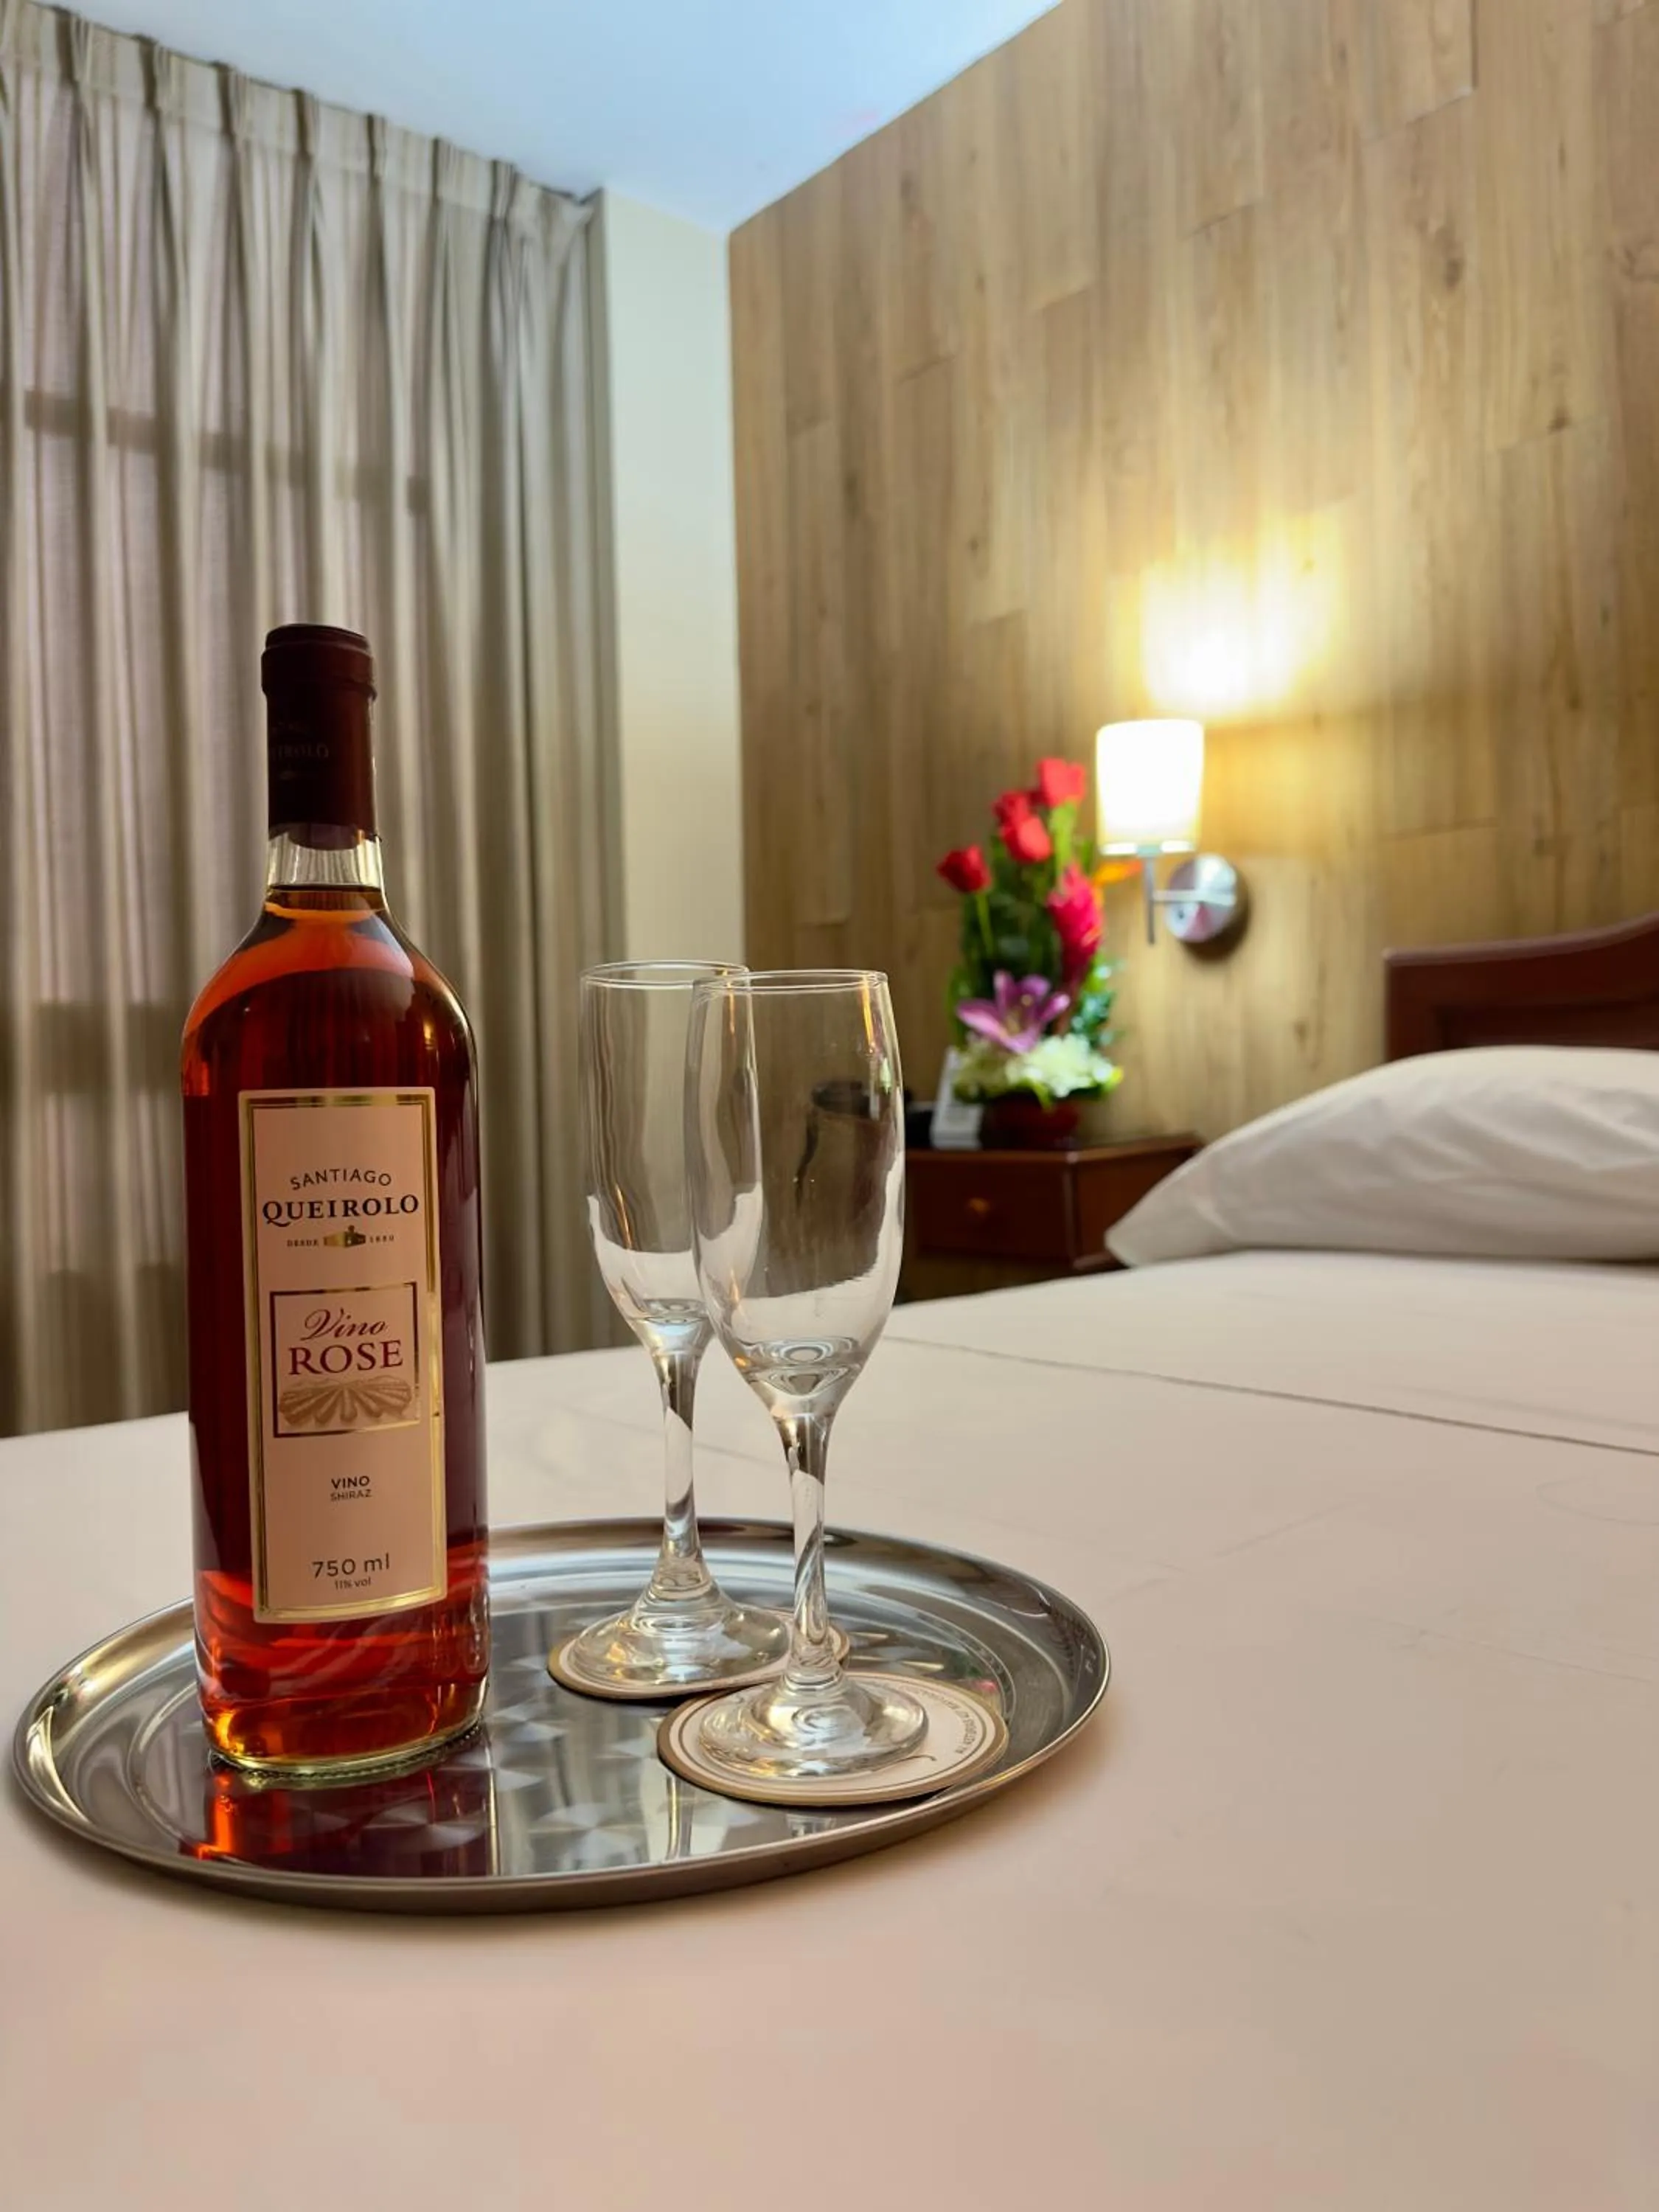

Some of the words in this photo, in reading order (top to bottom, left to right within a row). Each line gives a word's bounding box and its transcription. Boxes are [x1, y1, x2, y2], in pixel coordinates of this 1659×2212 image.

[290, 1168, 392, 1191] SANTIAGO
[262, 1194, 419, 1227] QUEIROLO
[286, 1239, 319, 1248] DESDE
[299, 1307, 389, 1341] Vino
[288, 1339, 404, 1375] ROSE
[331, 1475, 369, 1489] VINO
[330, 1489, 372, 1502] SHIRAZ
[312, 1558, 355, 1579] 750
[364, 1552, 390, 1572] ml
[334, 1579, 353, 1590] 11%
[355, 1576, 372, 1587] vol
